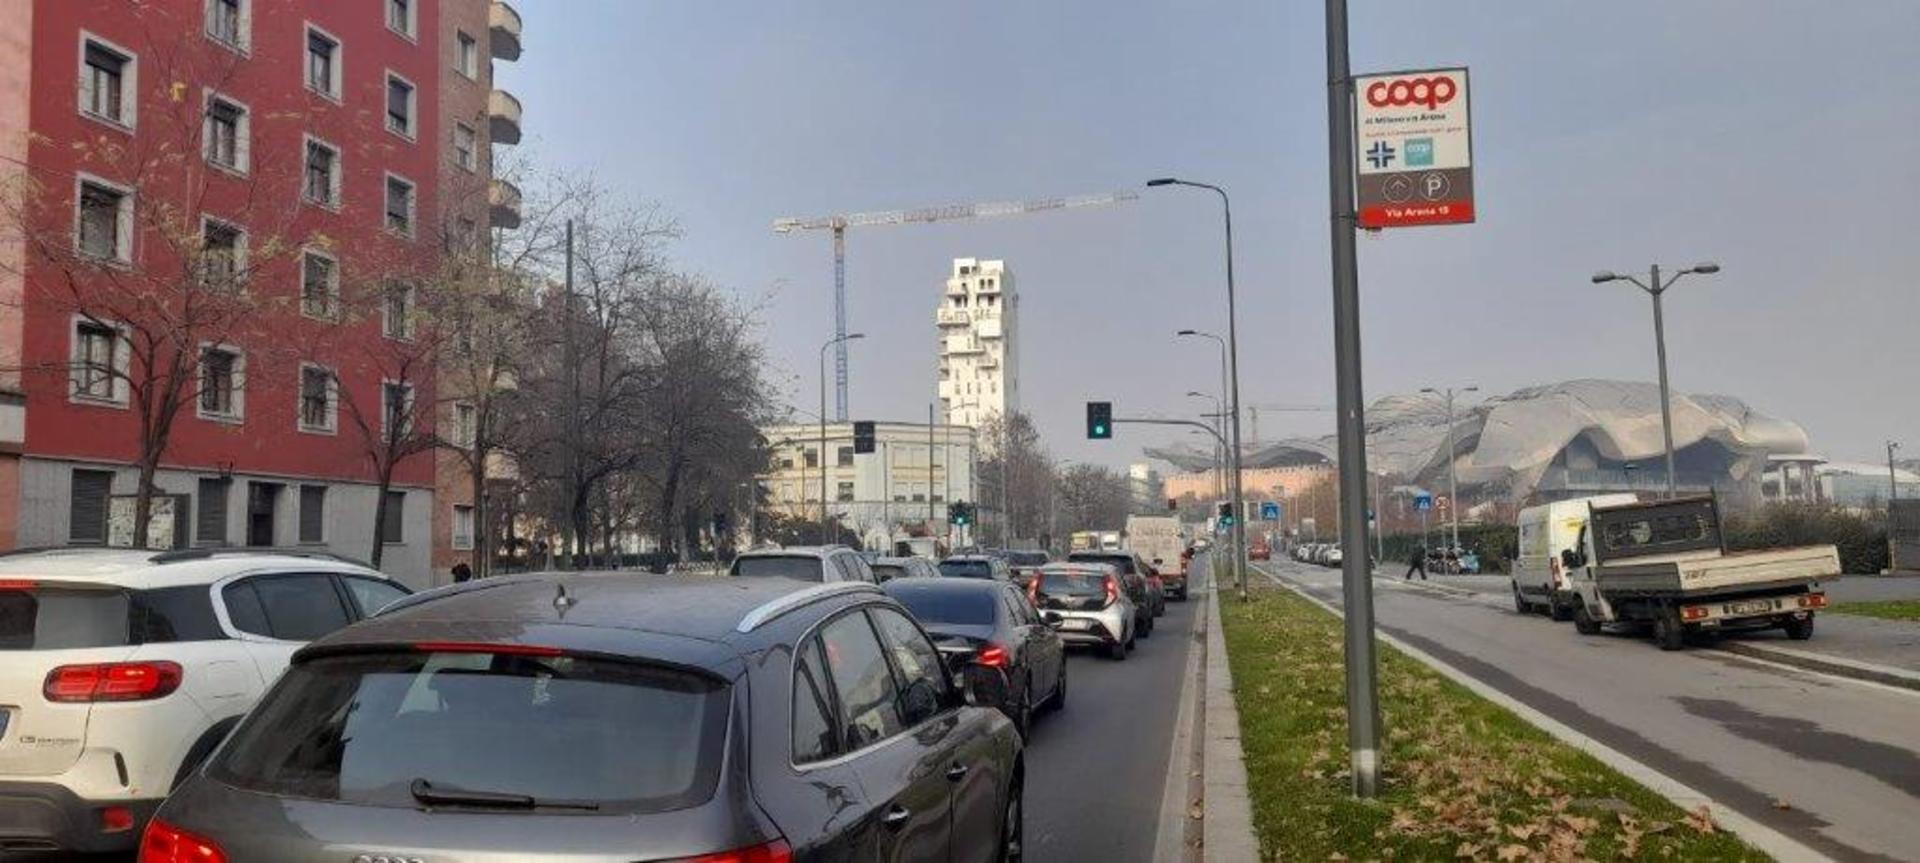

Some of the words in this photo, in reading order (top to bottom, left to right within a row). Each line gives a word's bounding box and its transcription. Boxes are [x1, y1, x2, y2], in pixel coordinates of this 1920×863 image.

[1367, 76, 1456, 110] coop
[1385, 207, 1403, 218] Via
[1404, 206, 1437, 217] Arena
